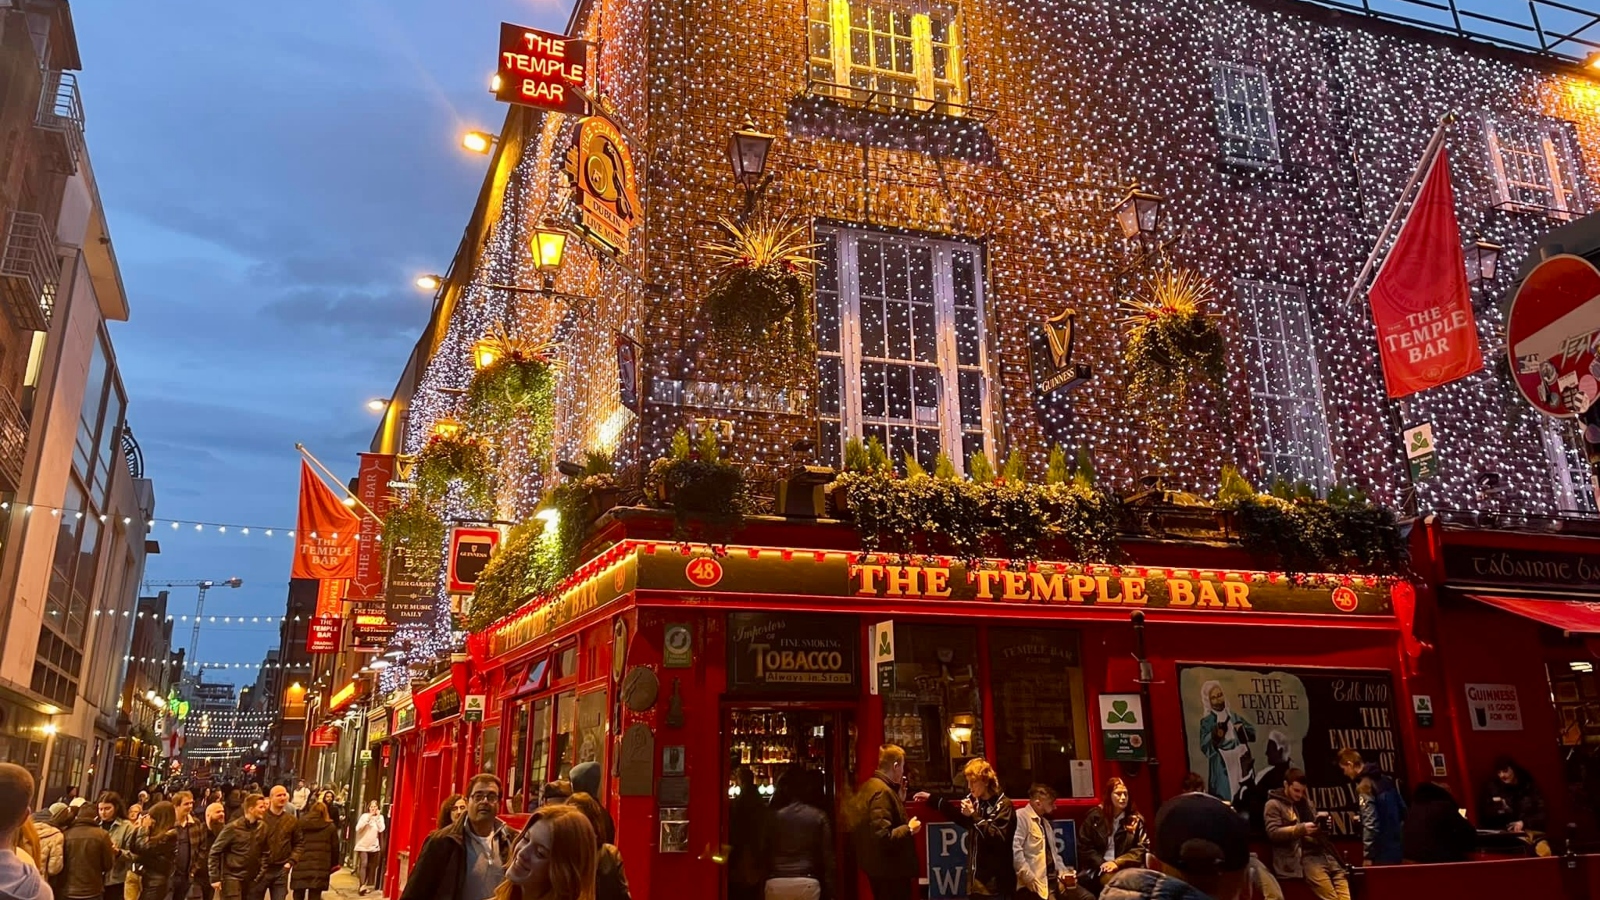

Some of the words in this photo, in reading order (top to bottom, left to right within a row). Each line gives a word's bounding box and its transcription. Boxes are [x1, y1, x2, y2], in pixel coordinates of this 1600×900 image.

[524, 33, 565, 57] THE
[503, 52, 585, 82] TEMPLE
[522, 78, 564, 101] BAR
[593, 201, 621, 228] DUBLIN
[586, 215, 603, 234] LIVE
[604, 229, 626, 250] MUSIC
[1406, 307, 1441, 327] THE
[1385, 310, 1468, 352] TEMPLE
[1408, 337, 1450, 364] BAR
[1042, 367, 1075, 392] GUINNESS
[358, 554, 370, 580] THE
[365, 474, 377, 498] BAR
[300, 544, 352, 556] TEMPLE
[316, 538, 338, 546] THE
[312, 556, 338, 565] BAR
[692, 562, 714, 580] 48
[851, 564, 952, 599] THE
[969, 570, 1148, 606] TEMPLE
[1166, 578, 1252, 608] BAR
[1336, 592, 1352, 606] 48
[505, 625, 523, 651] THE
[571, 583, 598, 616] BAR
[780, 638, 799, 647] FINE
[800, 639, 841, 648] SMOKING
[747, 643, 843, 678] TOBACCO
[767, 672, 803, 681] Always
[821, 672, 849, 682] Stock
[1250, 678, 1283, 694] THE
[1237, 693, 1299, 711] TEMPLE
[1364, 683, 1387, 702] 1840
[1468, 687, 1516, 701] GUINNESS
[1359, 707, 1390, 728] THE
[1488, 703, 1494, 711] IS
[1496, 703, 1516, 711] GOOD
[1255, 709, 1288, 727] BAR
[1329, 729, 1395, 750] EMPEROR
[1379, 751, 1395, 773] OF
